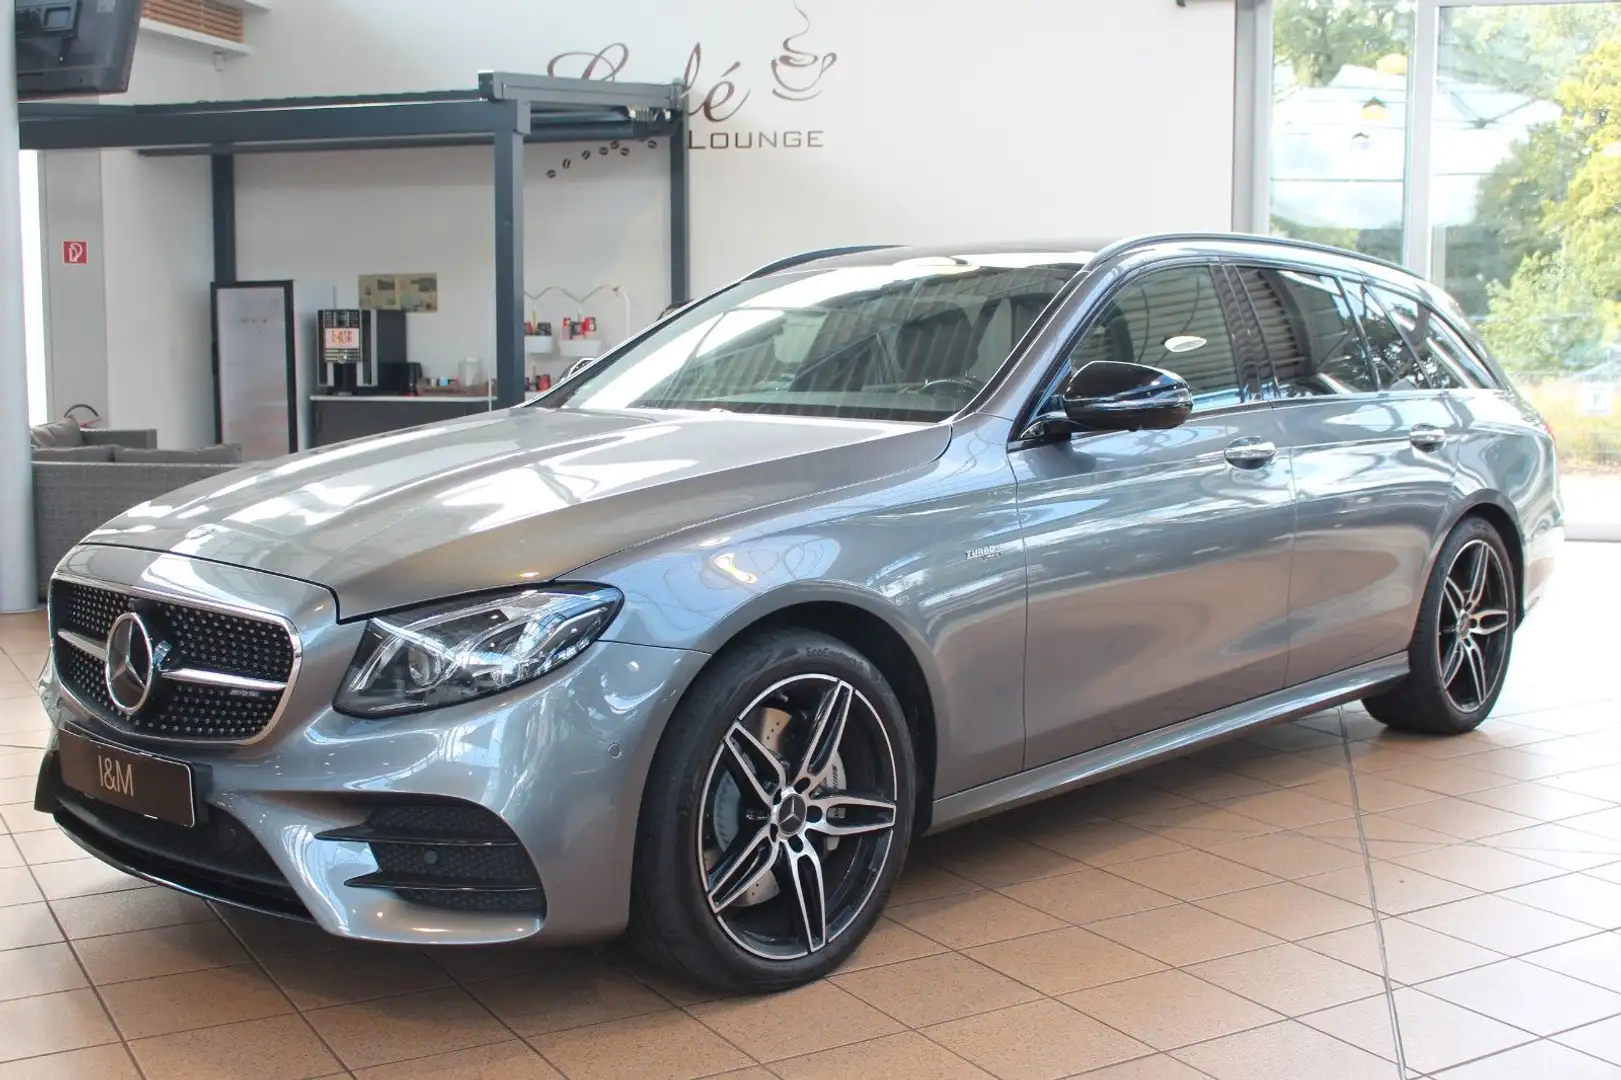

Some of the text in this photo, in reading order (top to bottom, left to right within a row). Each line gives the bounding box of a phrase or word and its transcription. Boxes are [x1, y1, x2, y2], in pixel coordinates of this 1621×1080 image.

[688, 129, 824, 149] LOUNGE
[965, 545, 997, 559] TURBO
[98, 755, 134, 796] I&M
